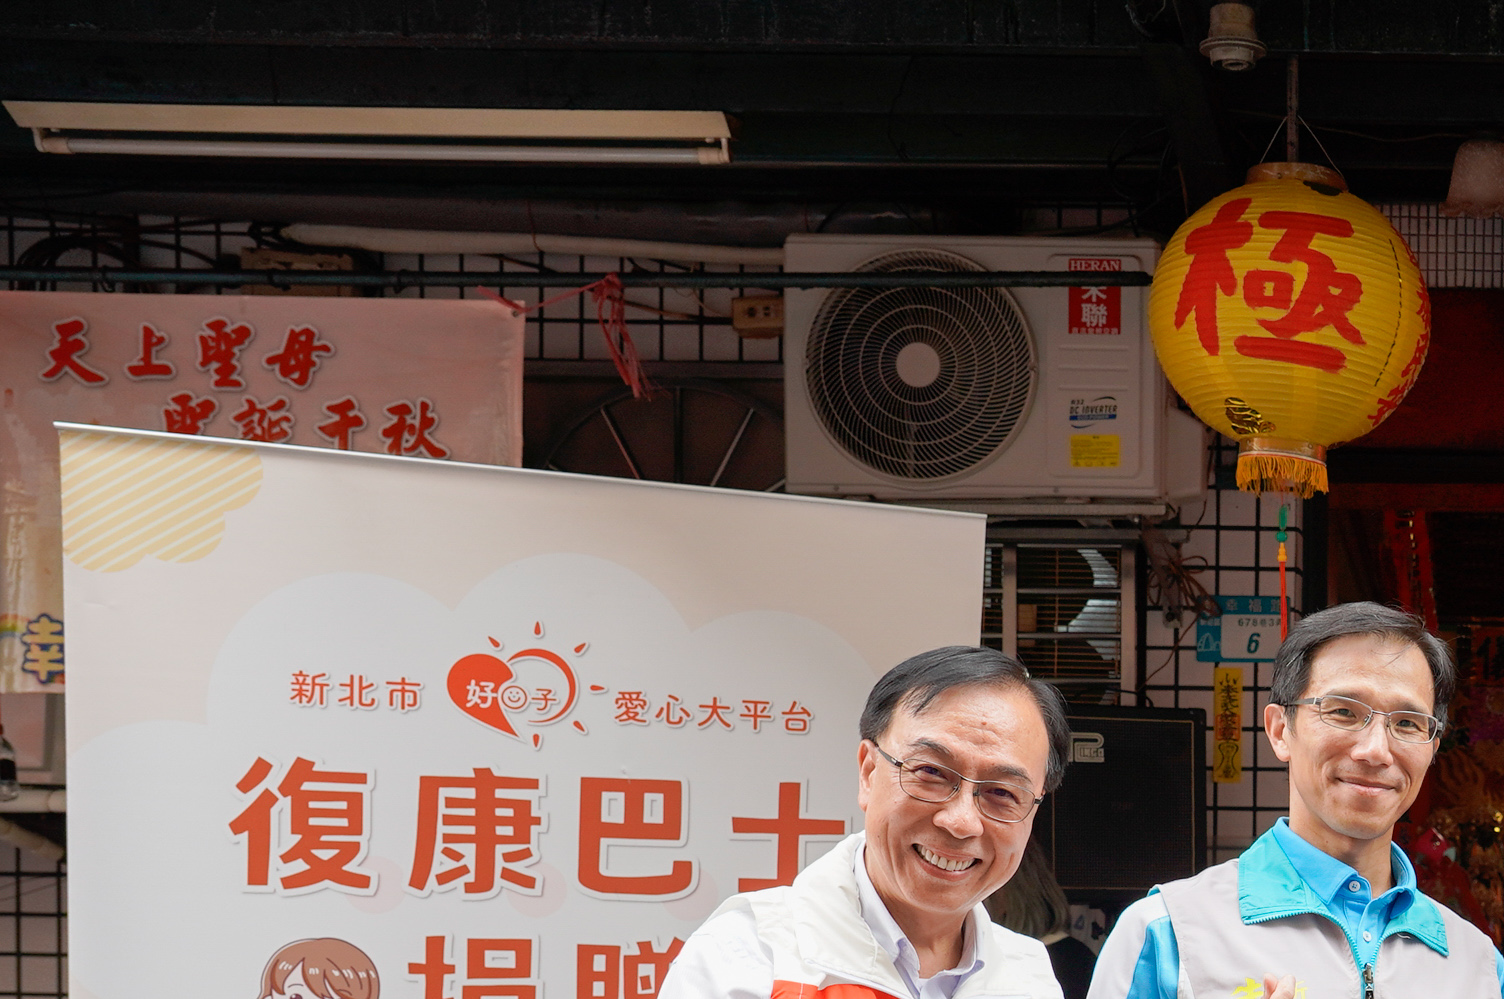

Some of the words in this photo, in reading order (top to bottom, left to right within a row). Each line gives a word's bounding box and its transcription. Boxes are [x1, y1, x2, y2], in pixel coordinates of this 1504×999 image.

[1070, 260, 1120, 271] HERAN
[1174, 198, 1365, 373] 極
[40, 319, 336, 388] 天上聖母
[1247, 633, 1261, 654] 6
[290, 671, 422, 709] 新北市
[614, 692, 812, 732] 愛心大平台
[228, 757, 846, 893] 復康巴士
